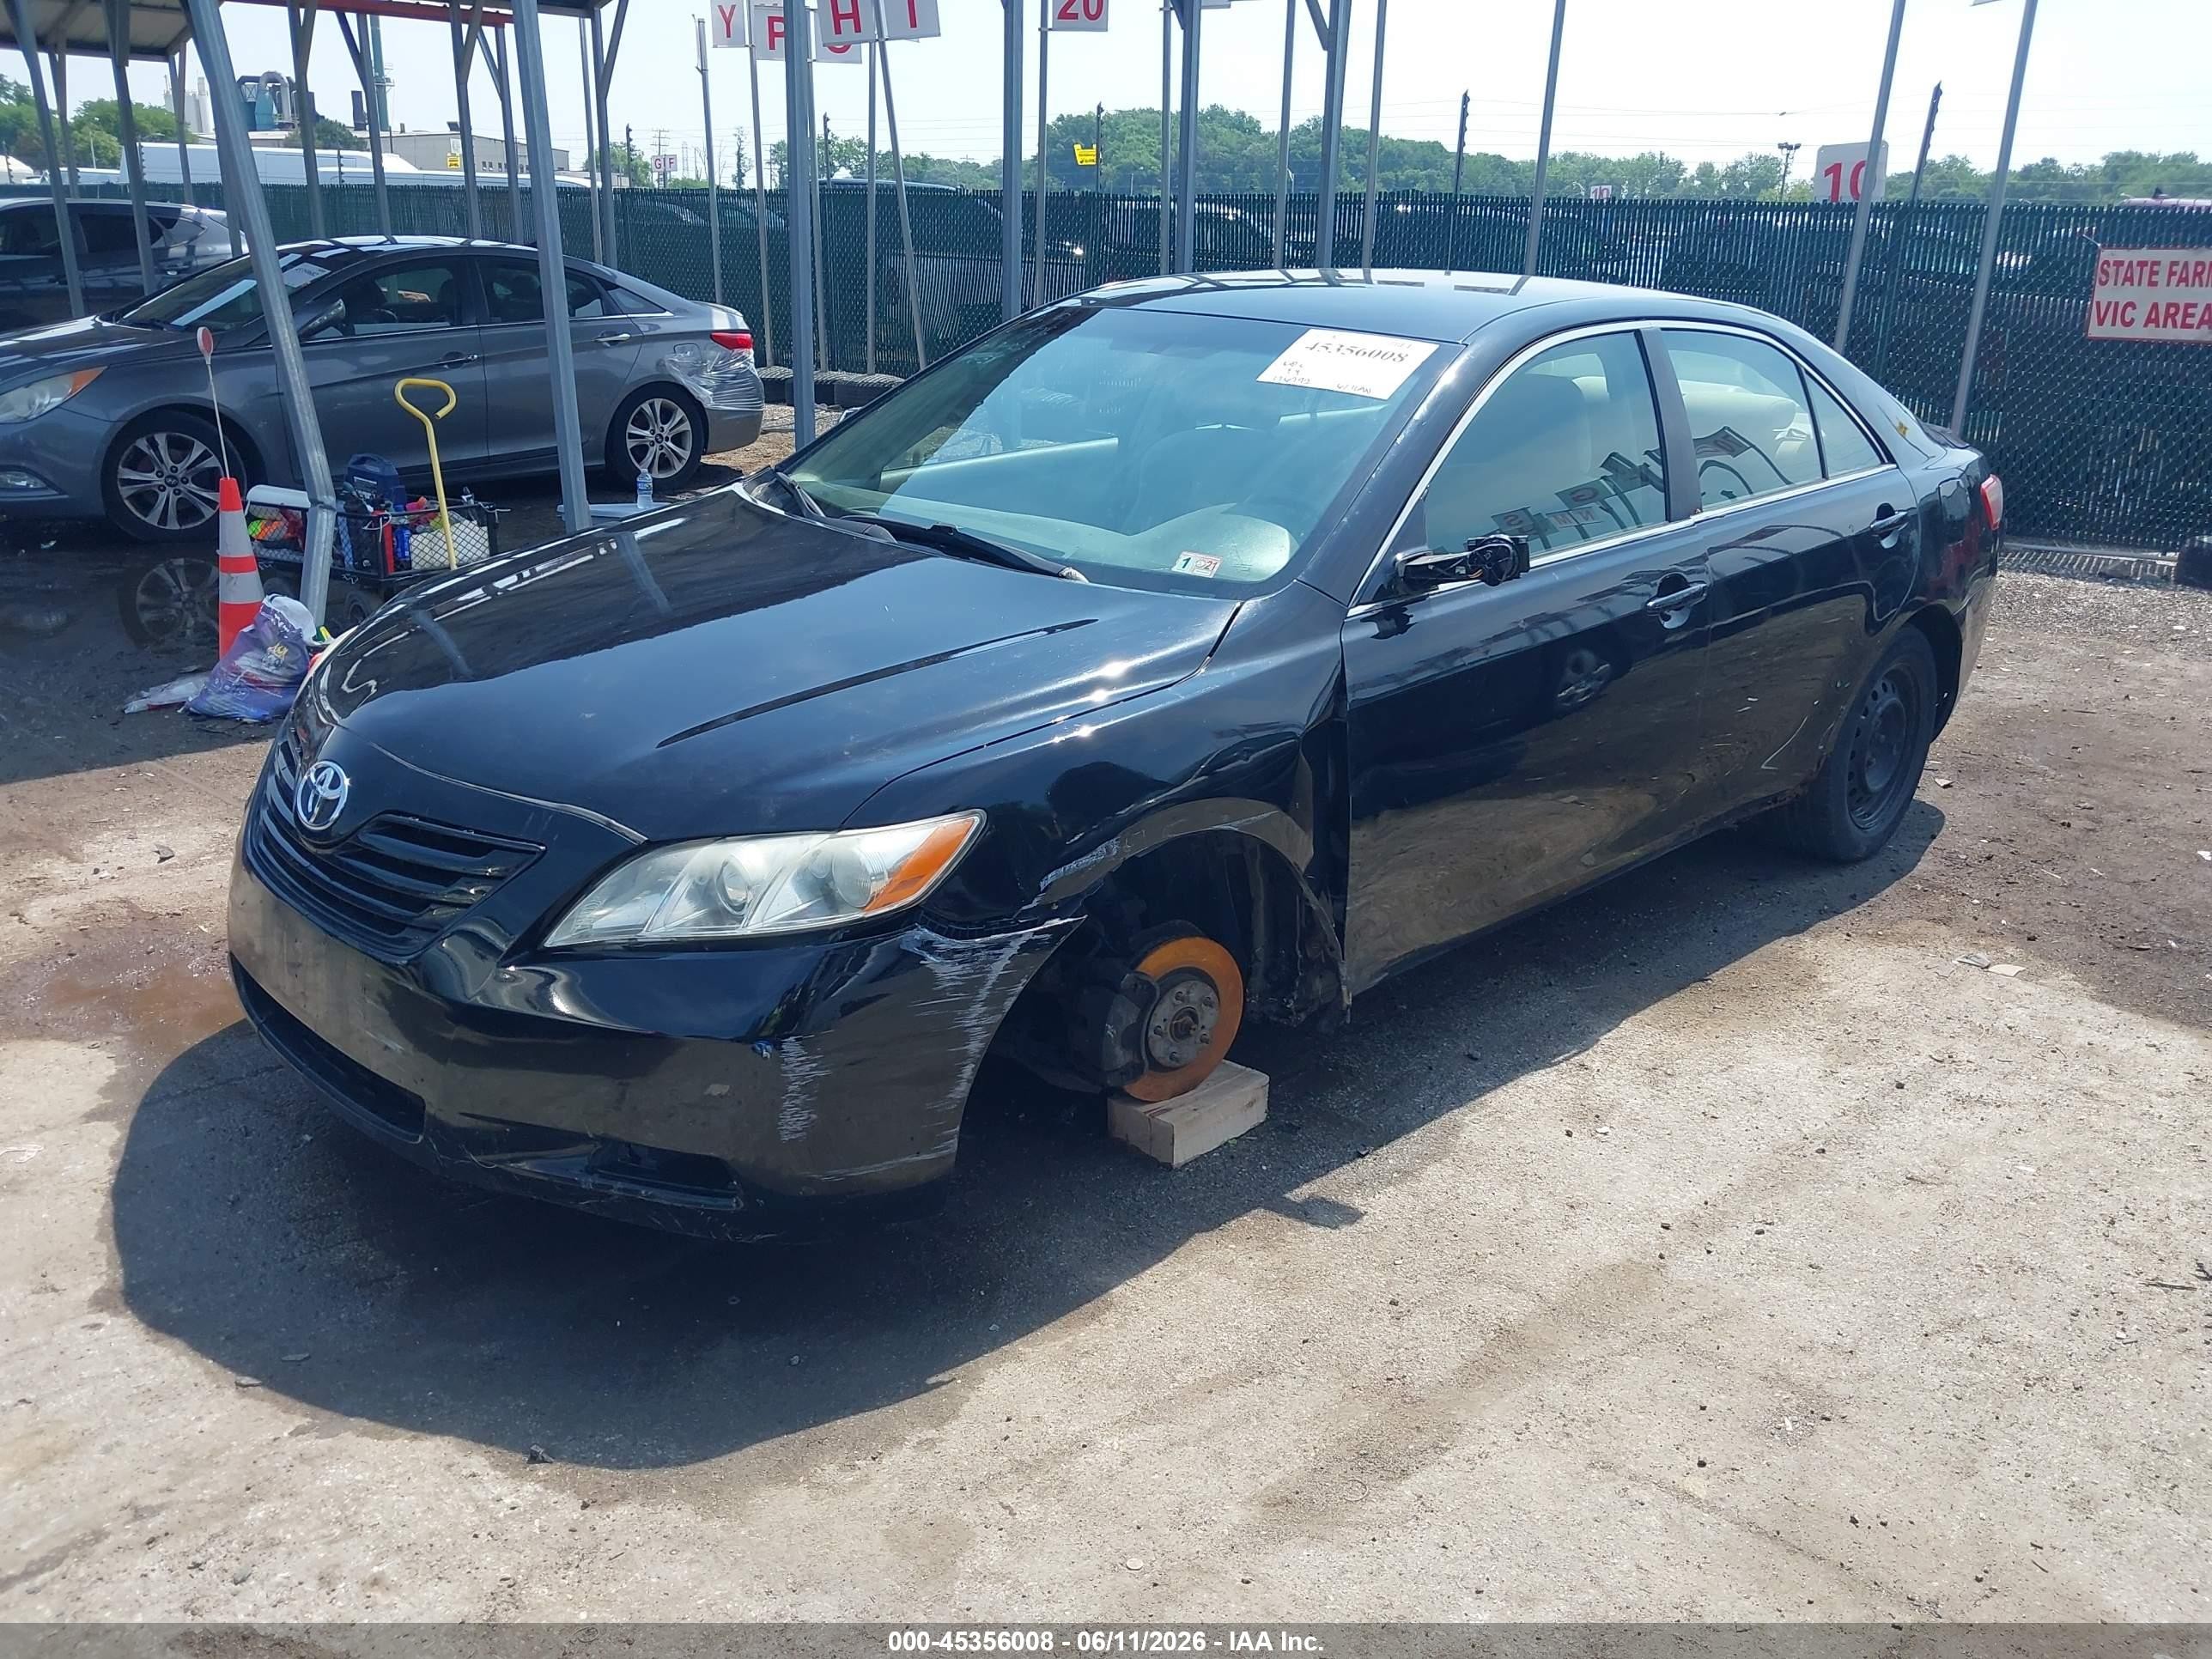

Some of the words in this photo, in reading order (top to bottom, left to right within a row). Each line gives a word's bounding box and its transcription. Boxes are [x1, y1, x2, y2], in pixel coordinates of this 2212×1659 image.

[718, 4, 737, 38] Y
[830, 0, 862, 35] H
[1057, 0, 1104, 21] 20
[654, 158, 662, 169] G
[668, 157, 675, 169] F
[2098, 259, 2161, 287] STATE
[2166, 260, 2212, 288] FAR
[2095, 301, 2136, 327] VIC
[2143, 301, 2212, 331] AREA
[1182, 556, 1191, 569] 1
[1204, 560, 1218, 571] 21
